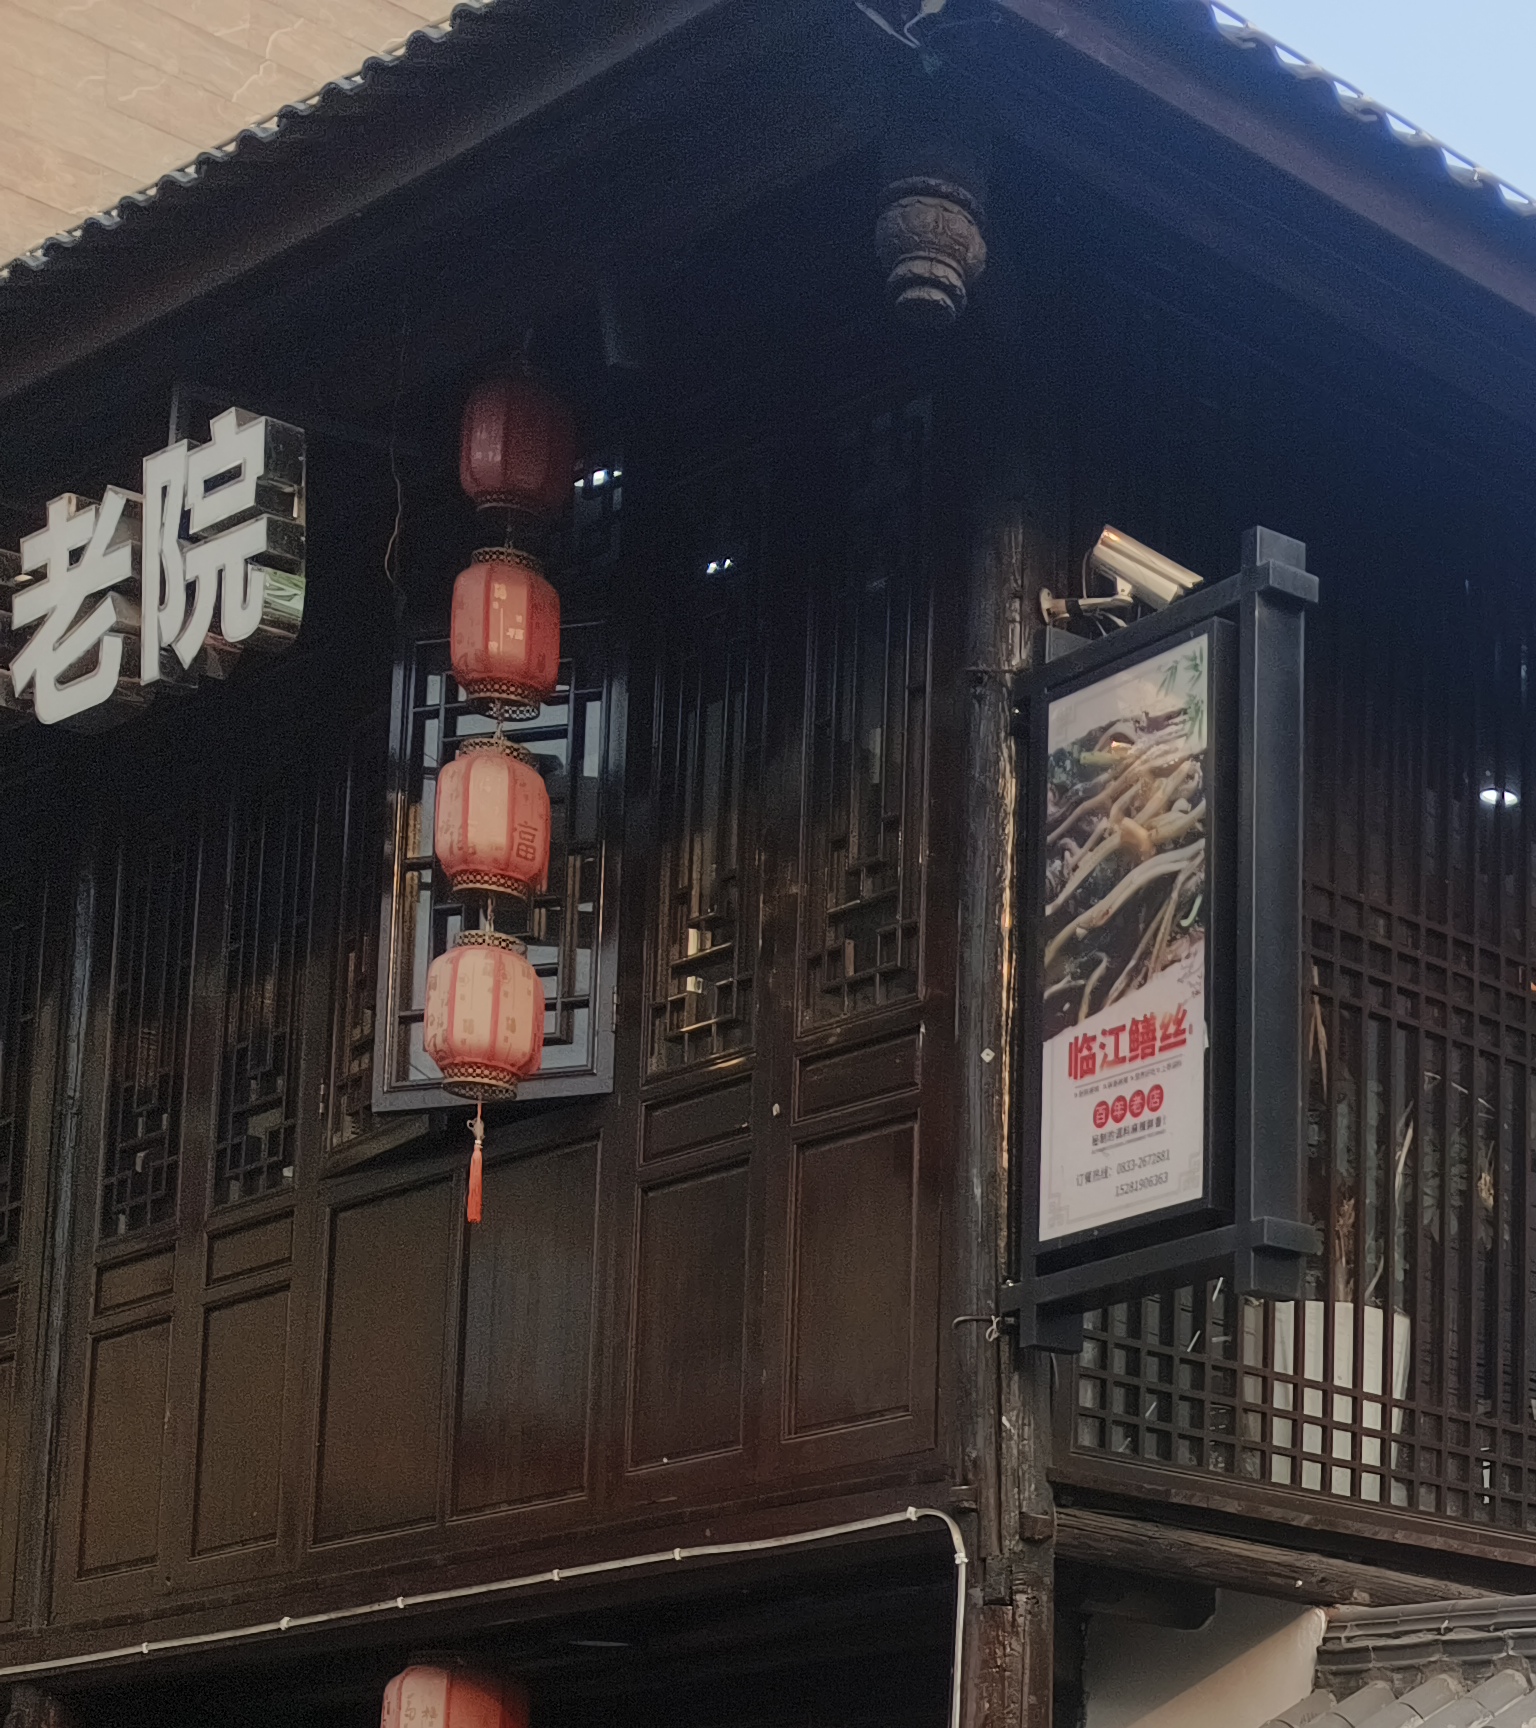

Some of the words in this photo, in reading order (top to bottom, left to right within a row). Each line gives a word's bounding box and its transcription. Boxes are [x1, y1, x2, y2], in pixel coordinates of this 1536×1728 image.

[9, 406, 268, 725] 老院
[1067, 1003, 1188, 1081] 临江鳝丝
[1093, 1085, 1164, 1128] 百年老店
